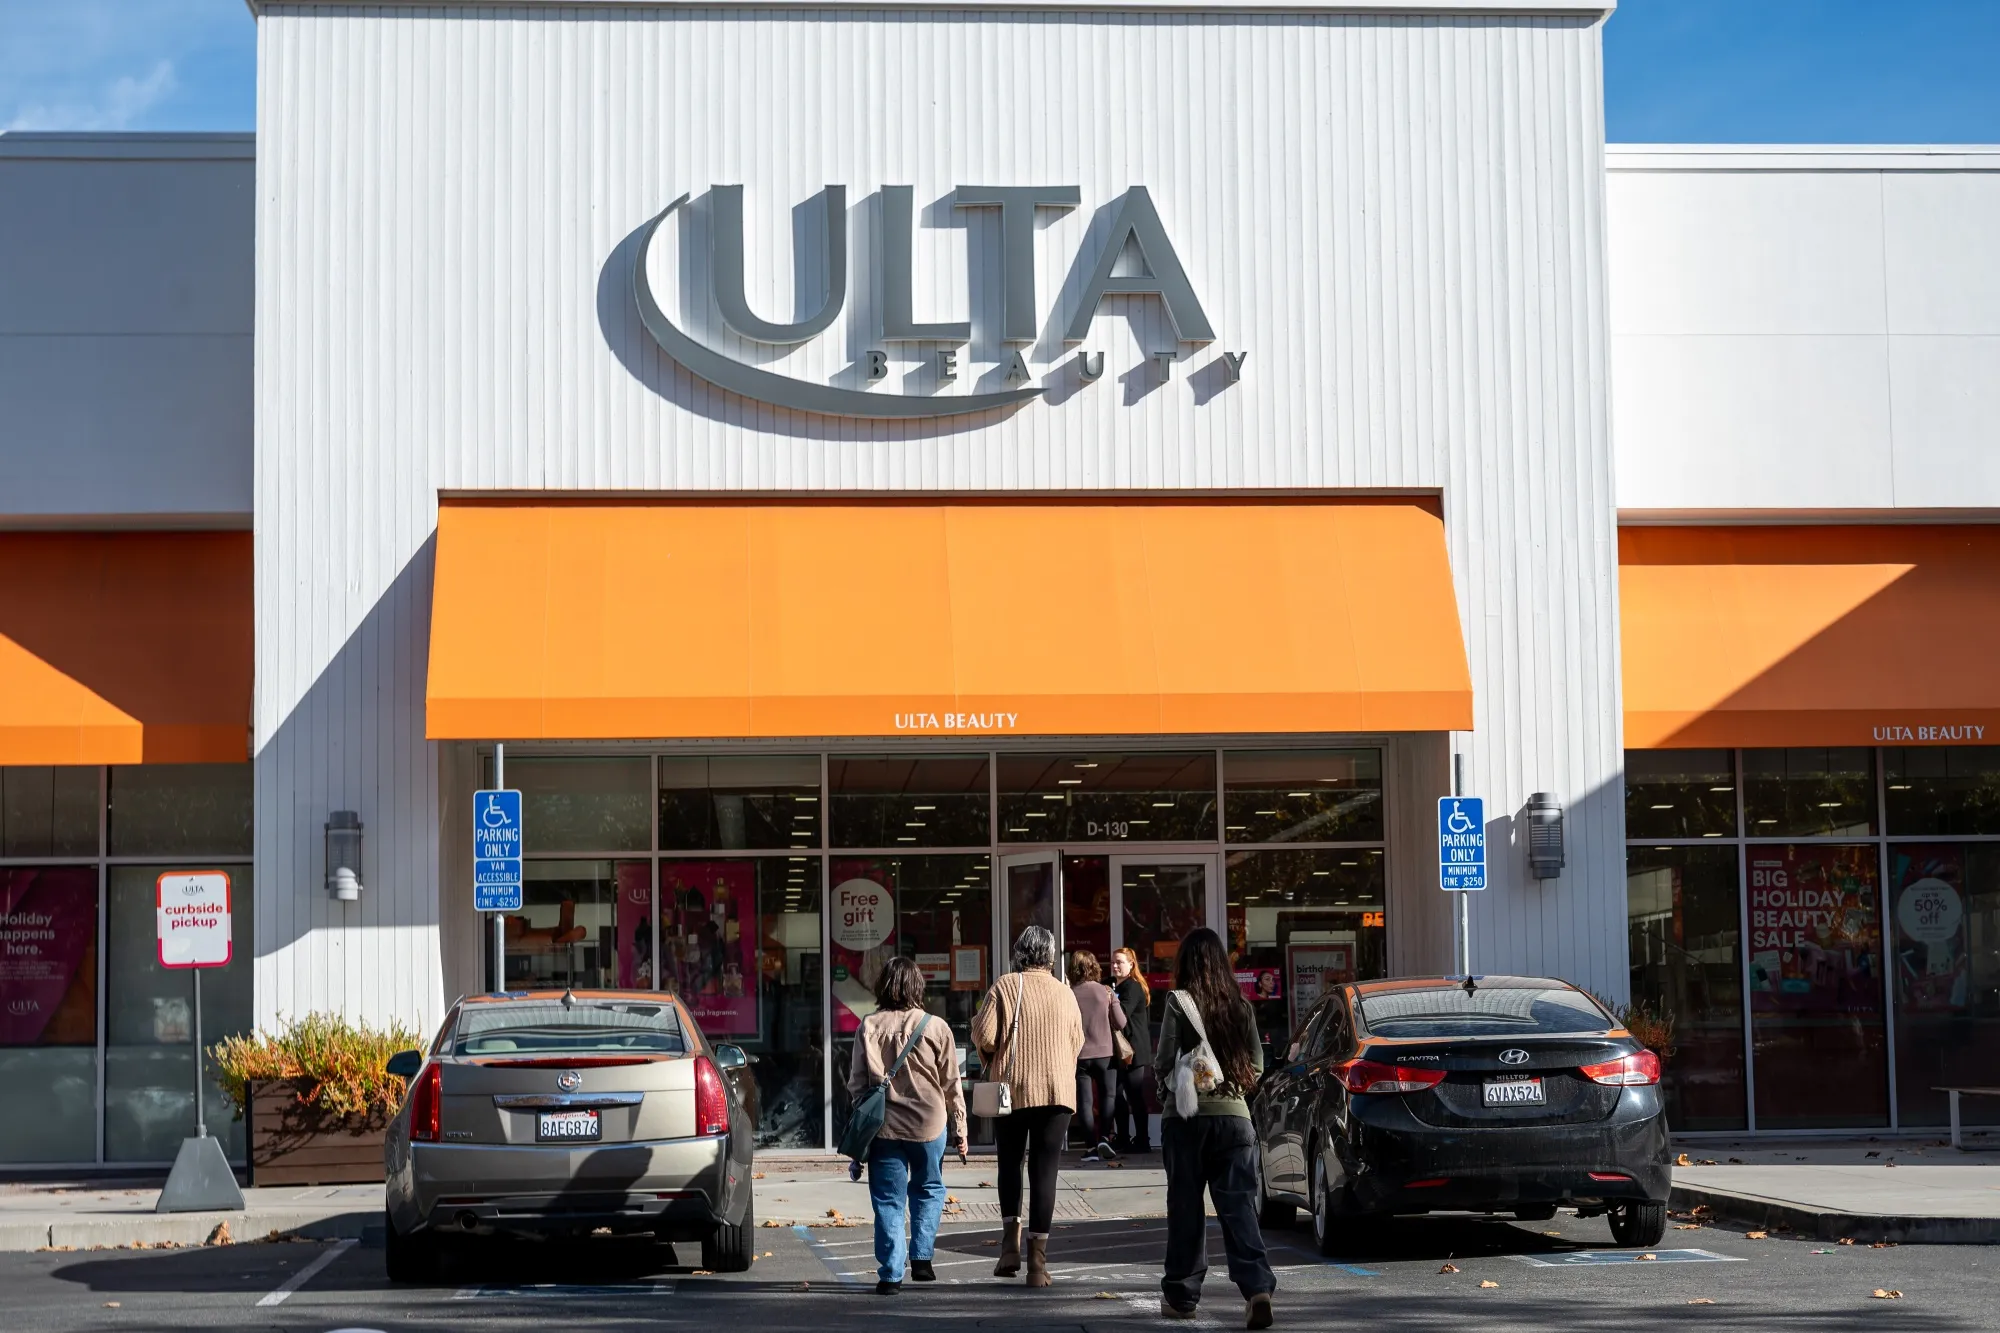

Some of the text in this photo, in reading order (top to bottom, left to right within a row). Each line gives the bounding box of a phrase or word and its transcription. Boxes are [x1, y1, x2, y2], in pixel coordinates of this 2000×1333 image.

[706, 184, 1216, 344] ULTA
[866, 350, 1248, 382] BEAUTY
[895, 713, 1018, 729] ULTA BEAUTY
[1873, 725, 1985, 741] ULTA BEAUTY
[477, 828, 519, 842] PARKING
[1087, 821, 1129, 836] D-130
[1442, 833, 1483, 847] PARKING
[484, 843, 511, 857] ONLY
[1450, 848, 1476, 862] ONLY
[490, 861, 506, 871] VAN
[1447, 866, 1478, 875] MINIMUM
[477, 872, 519, 883] ACCESSIBLE
[1443, 877, 1483, 887] FINE $250
[1752, 870, 1788, 887] BIG
[482, 886, 514, 896] MINIMUM
[477, 897, 519, 907] FINE $250
[840, 891, 879, 907] Free
[1753, 890, 1846, 907] HOLIDAY
[1914, 898, 1948, 912] 50%
[165, 902, 223, 915] curbside
[0, 912, 53, 929] Holiday
[171, 916, 218, 930] pickup
[1753, 910, 1837, 928] BEAUTY
[1920, 912, 1940, 925] off
[1753, 930, 1806, 948] SALE
[6, 943, 43, 956] here.
[10, 1000, 41, 1013] ULTA
